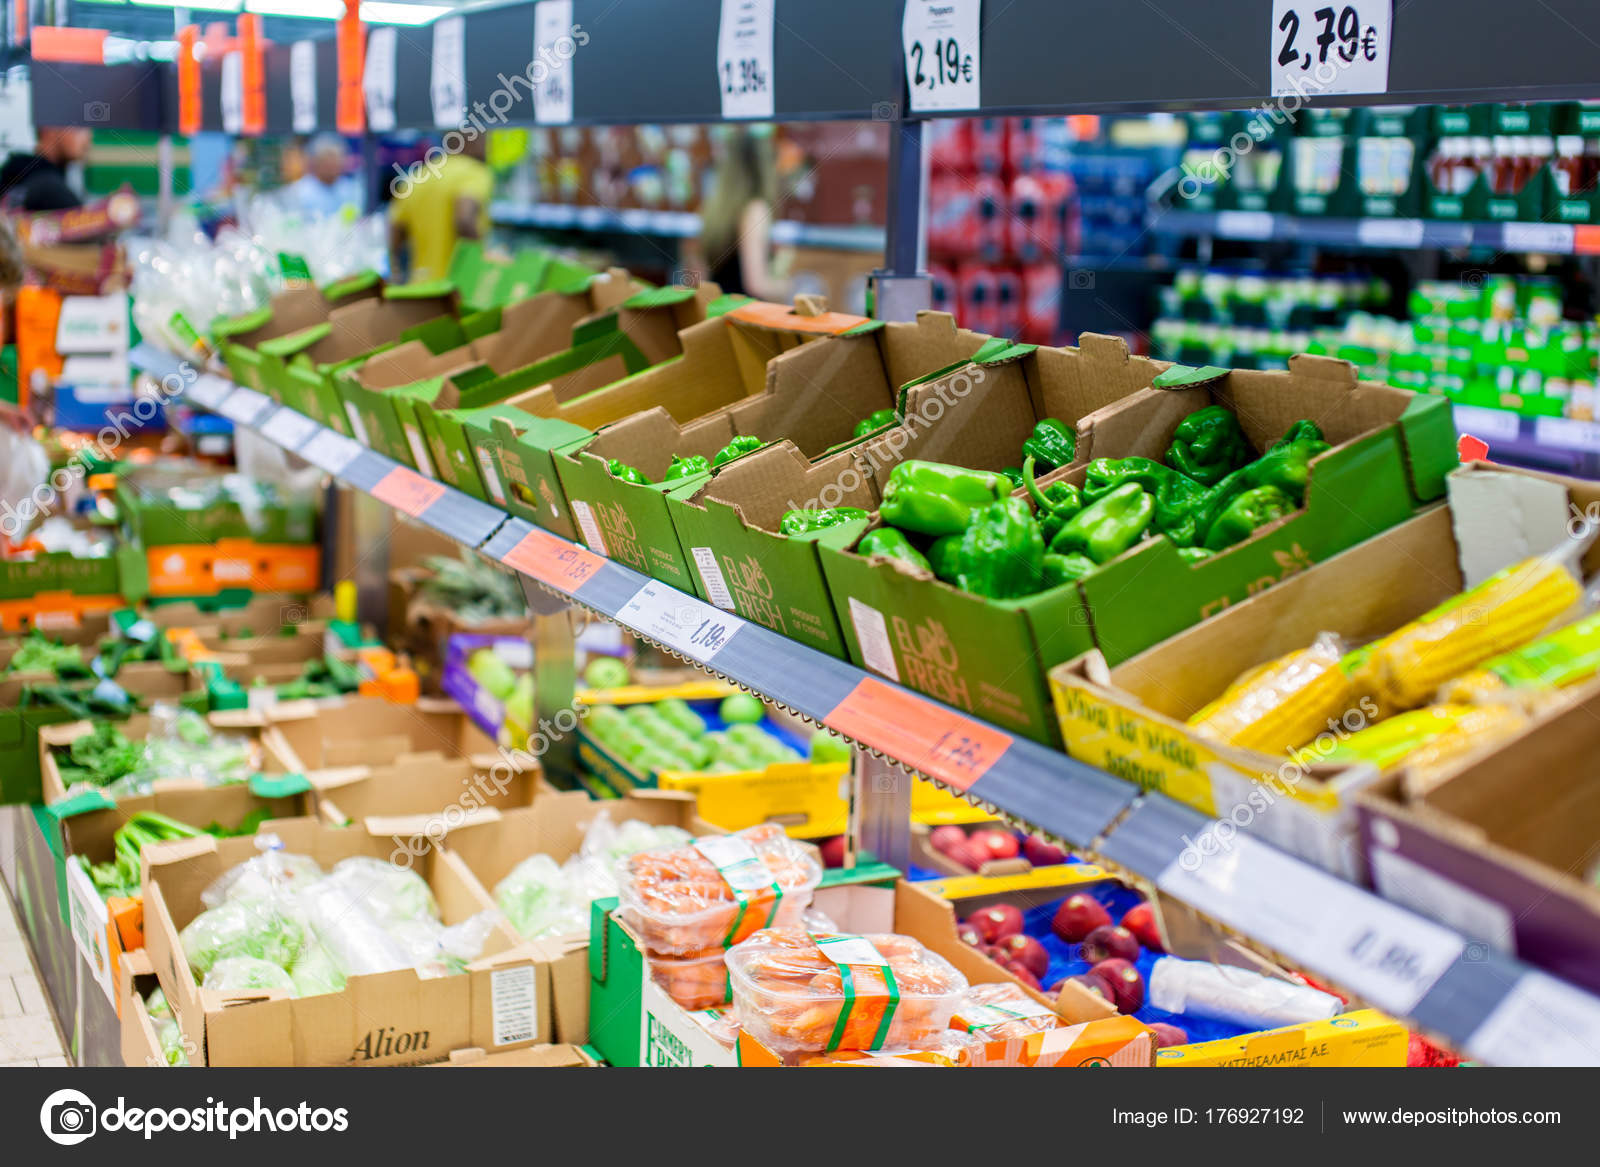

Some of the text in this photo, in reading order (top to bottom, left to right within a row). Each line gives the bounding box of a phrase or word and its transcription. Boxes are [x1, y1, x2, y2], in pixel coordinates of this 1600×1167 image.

[1278, 5, 1377, 70] 2,79€
[911, 37, 974, 90] 2,19€
[596, 501, 637, 541] EURO
[607, 531, 649, 571] FRESH
[722, 554, 774, 600] EURO
[734, 587, 788, 635] FRESH
[690, 618, 726, 652] 1,19€
[891, 615, 960, 672] EURO
[903, 653, 975, 713] FRESH
[348, 1026, 430, 1061] Alion
